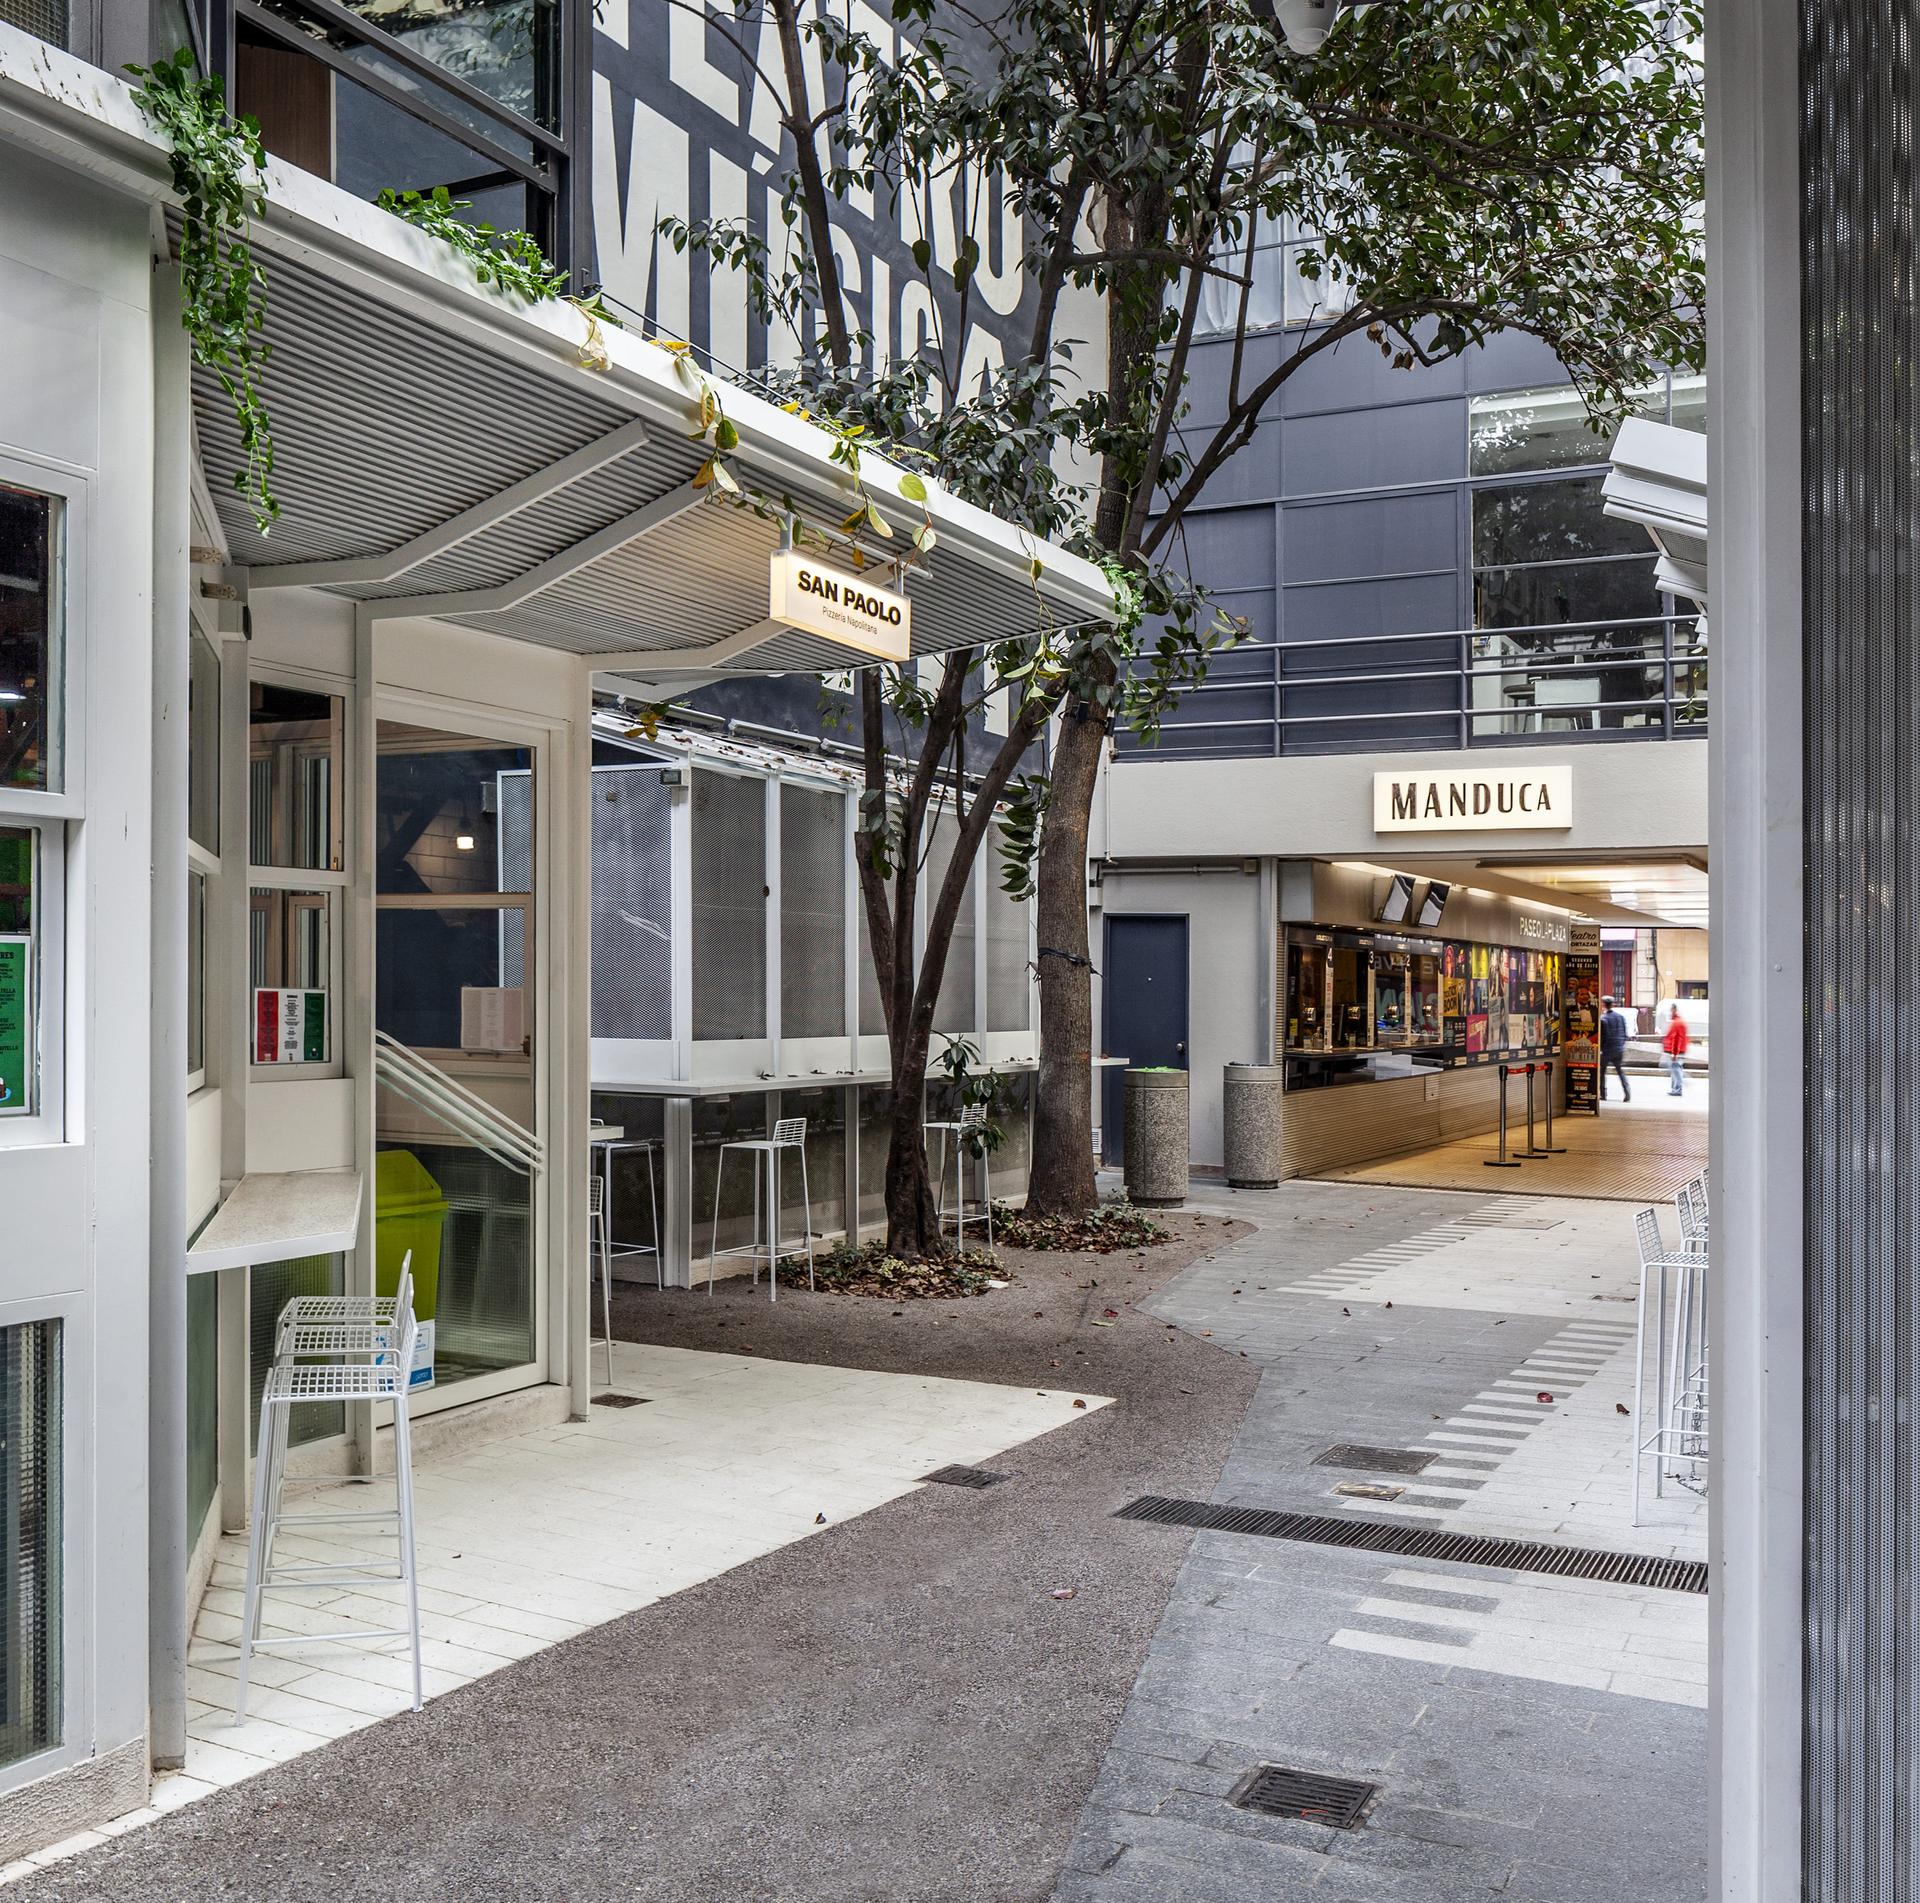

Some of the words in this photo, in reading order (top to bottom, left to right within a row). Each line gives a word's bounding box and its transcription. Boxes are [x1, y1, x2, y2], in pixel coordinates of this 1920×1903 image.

[797, 570, 838, 602] SAN
[843, 587, 901, 626] PAOLO
[822, 606, 846, 622] Pizzeria
[847, 615, 878, 635] Napolitana
[1391, 783, 1552, 820] MANDUCA
[1519, 916, 1541, 938] PASEO
[1548, 922, 1567, 943] PLAZA
[1368, 950, 1375, 964] 3
